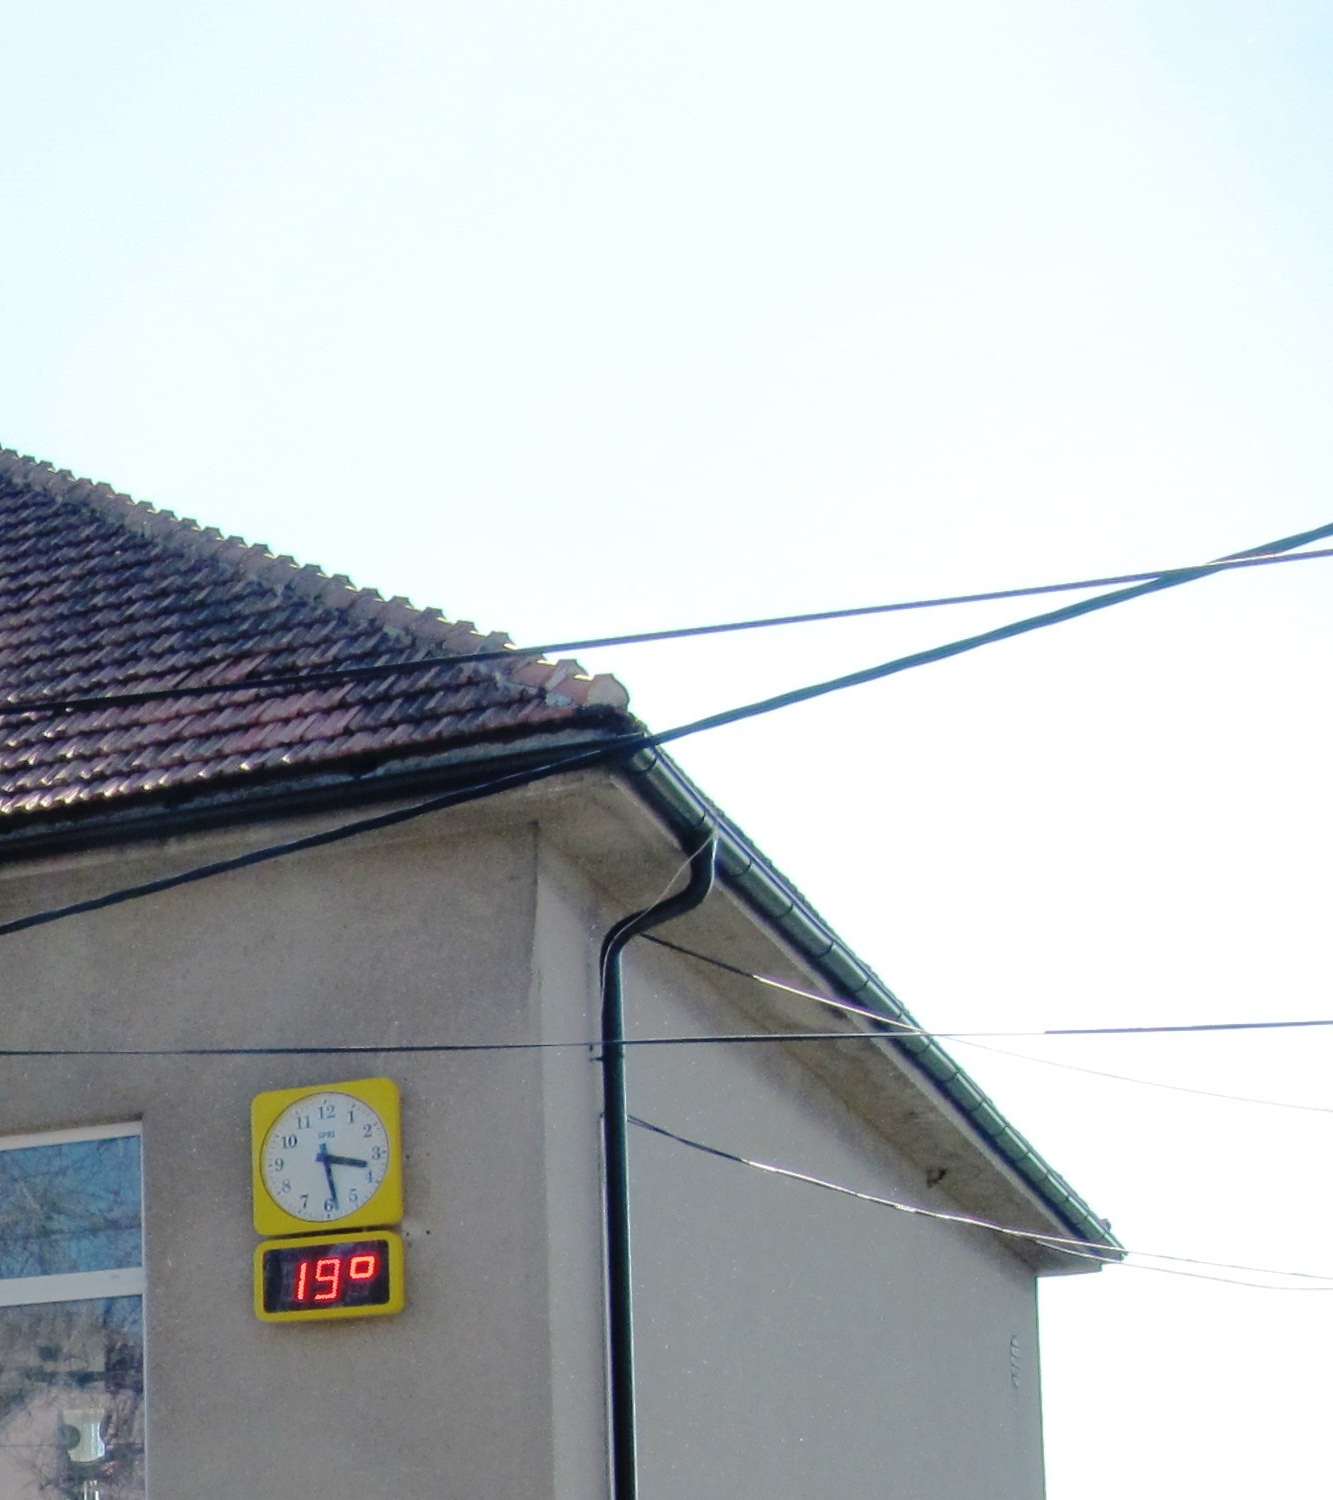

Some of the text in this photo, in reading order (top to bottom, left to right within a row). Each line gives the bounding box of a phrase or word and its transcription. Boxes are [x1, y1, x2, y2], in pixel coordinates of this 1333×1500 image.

[319, 1105, 335, 1119] 12
[348, 1110, 354, 1123] 1
[297, 1116, 310, 1130] 11
[363, 1123, 372, 1138] 2
[281, 1135, 298, 1149] 10
[372, 1146, 381, 1160] 3
[275, 1158, 284, 1172] 9
[365, 1169, 374, 1184] 4
[282, 1179, 292, 1193] 8
[300, 1194, 309, 1209] 7
[349, 1188, 358, 1203] 5
[324, 1199, 334, 1213] 6
